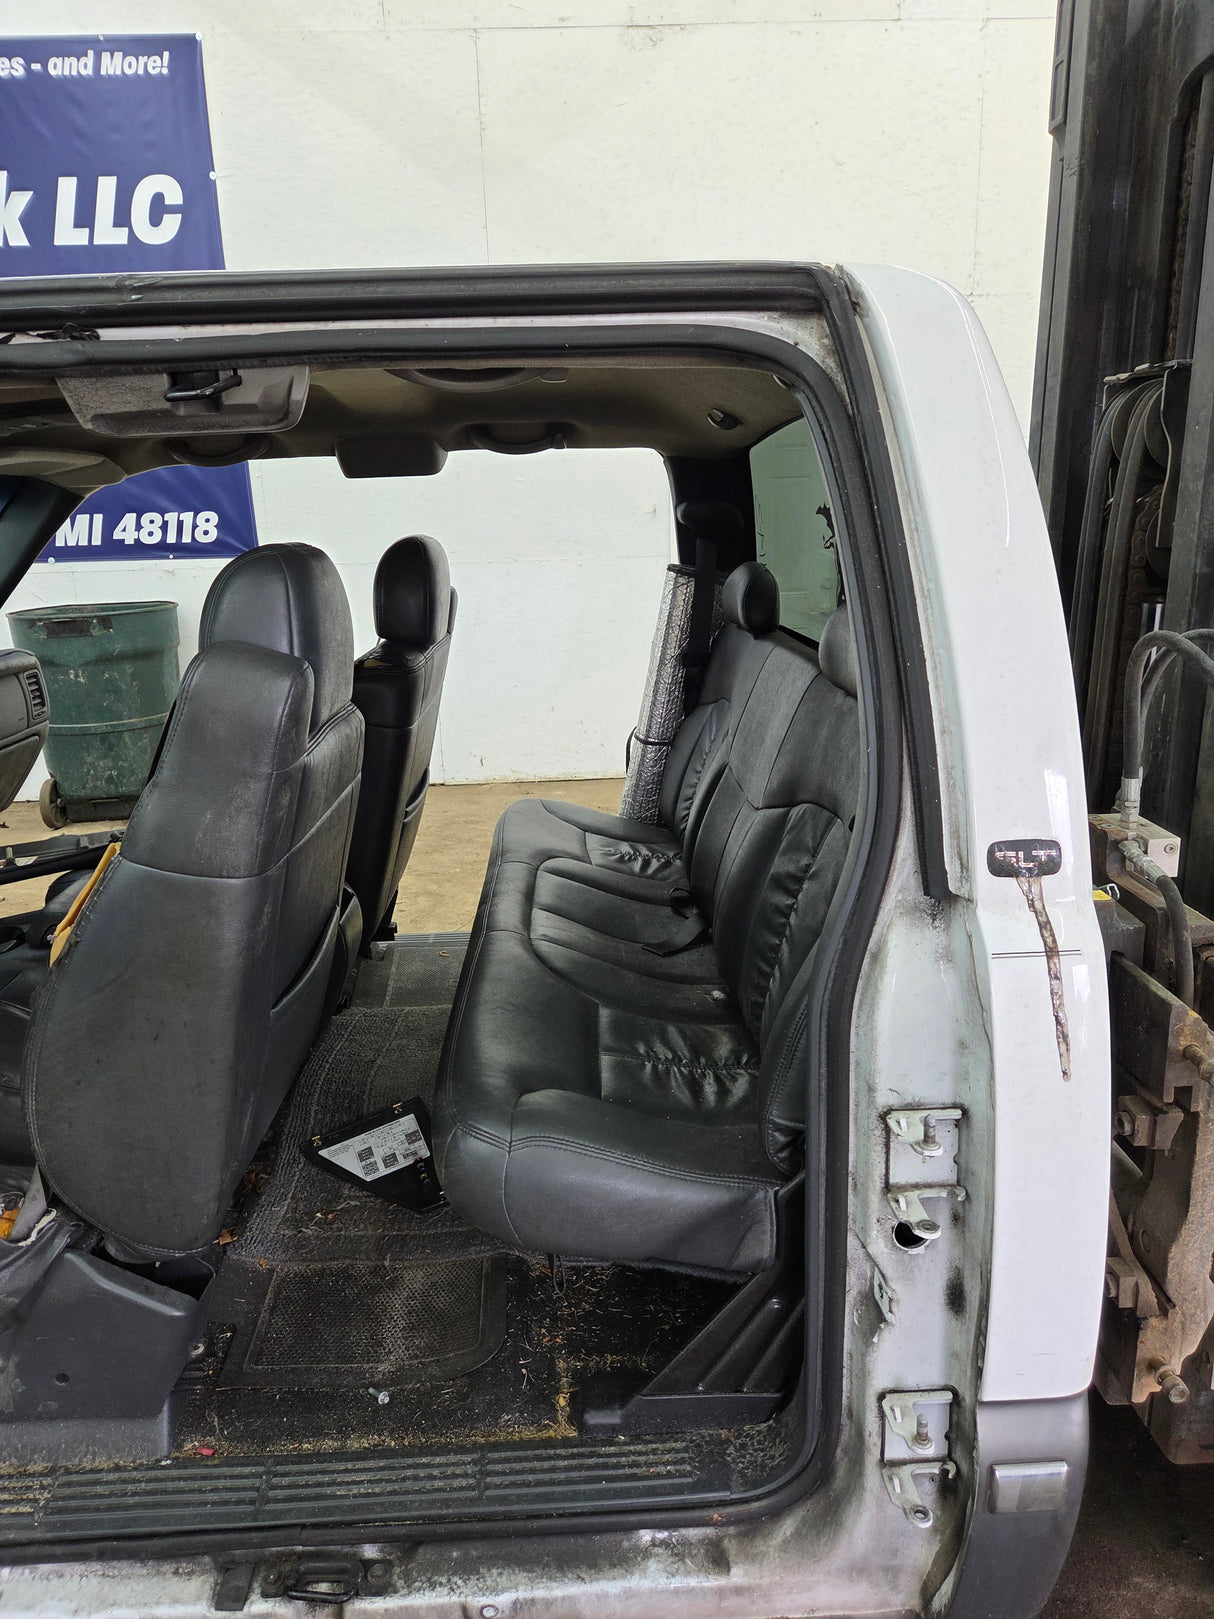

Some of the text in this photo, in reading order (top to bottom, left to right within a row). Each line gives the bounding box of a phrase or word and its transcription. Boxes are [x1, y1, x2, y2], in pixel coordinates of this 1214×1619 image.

[0, 56, 25, 77] es
[47, 49, 94, 76] and
[100, 50, 170, 76] More!
[53, 173, 184, 246] LLC
[55, 511, 219, 547] MI 48118
